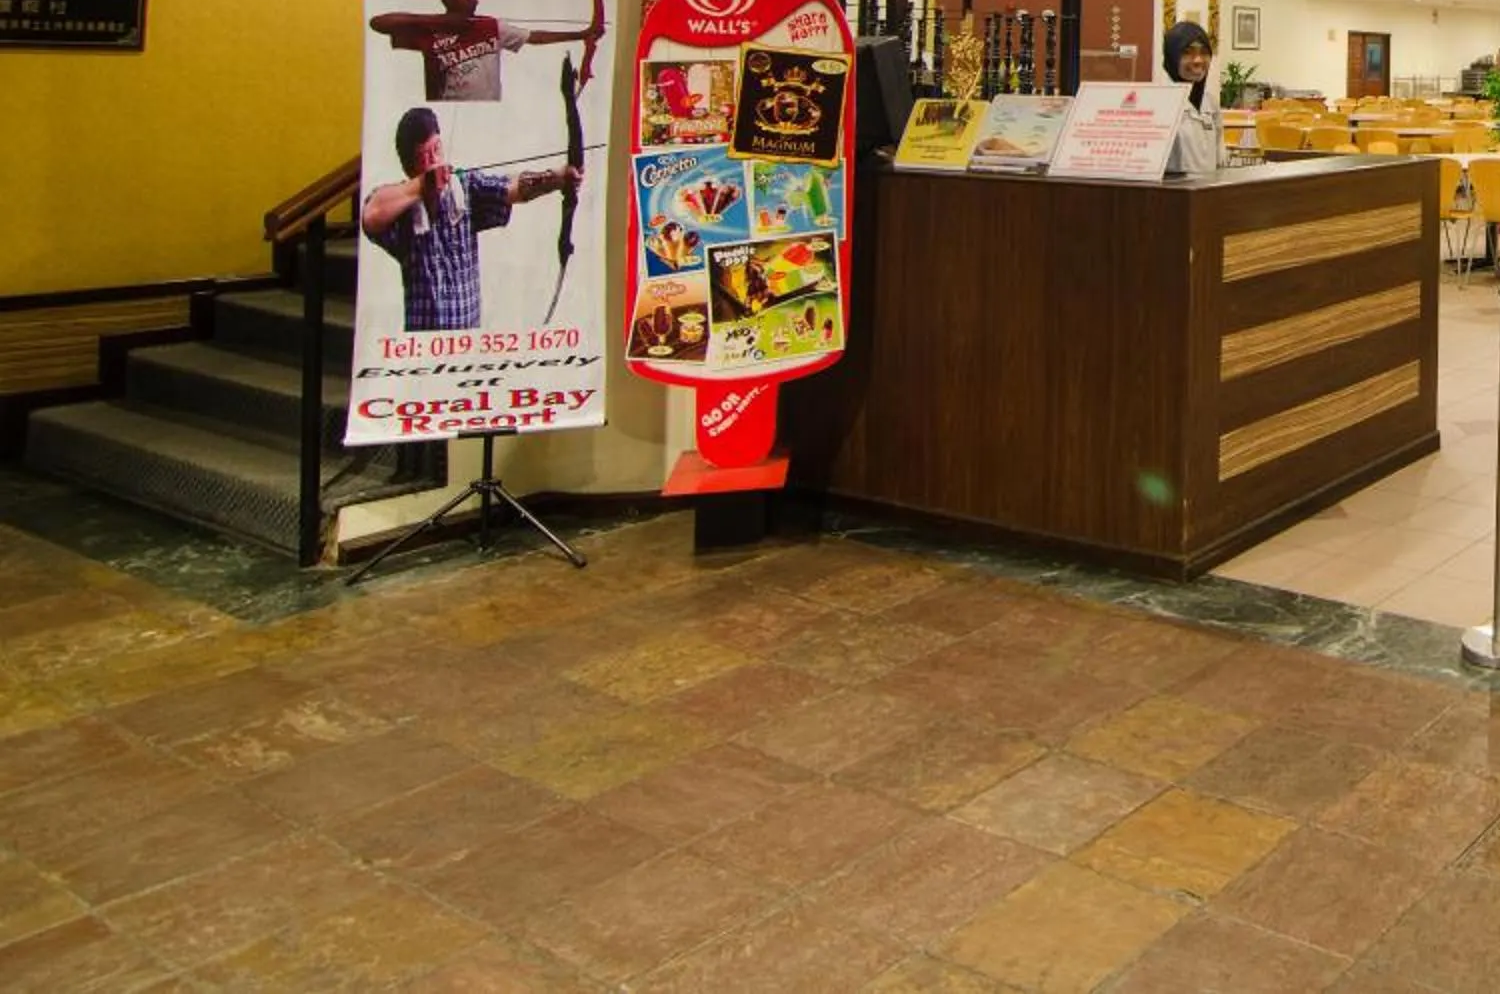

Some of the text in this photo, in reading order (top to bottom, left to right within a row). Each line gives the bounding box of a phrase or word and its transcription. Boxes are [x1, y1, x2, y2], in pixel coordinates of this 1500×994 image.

[687, 18, 751, 35] WALL'S
[751, 136, 816, 153] MAGNUM
[379, 328, 580, 360] Tel: 019 352 1670
[356, 355, 604, 378] Exclusively
[457, 376, 504, 388] at
[357, 387, 597, 419] Coral Bay
[397, 407, 557, 436] Resort
